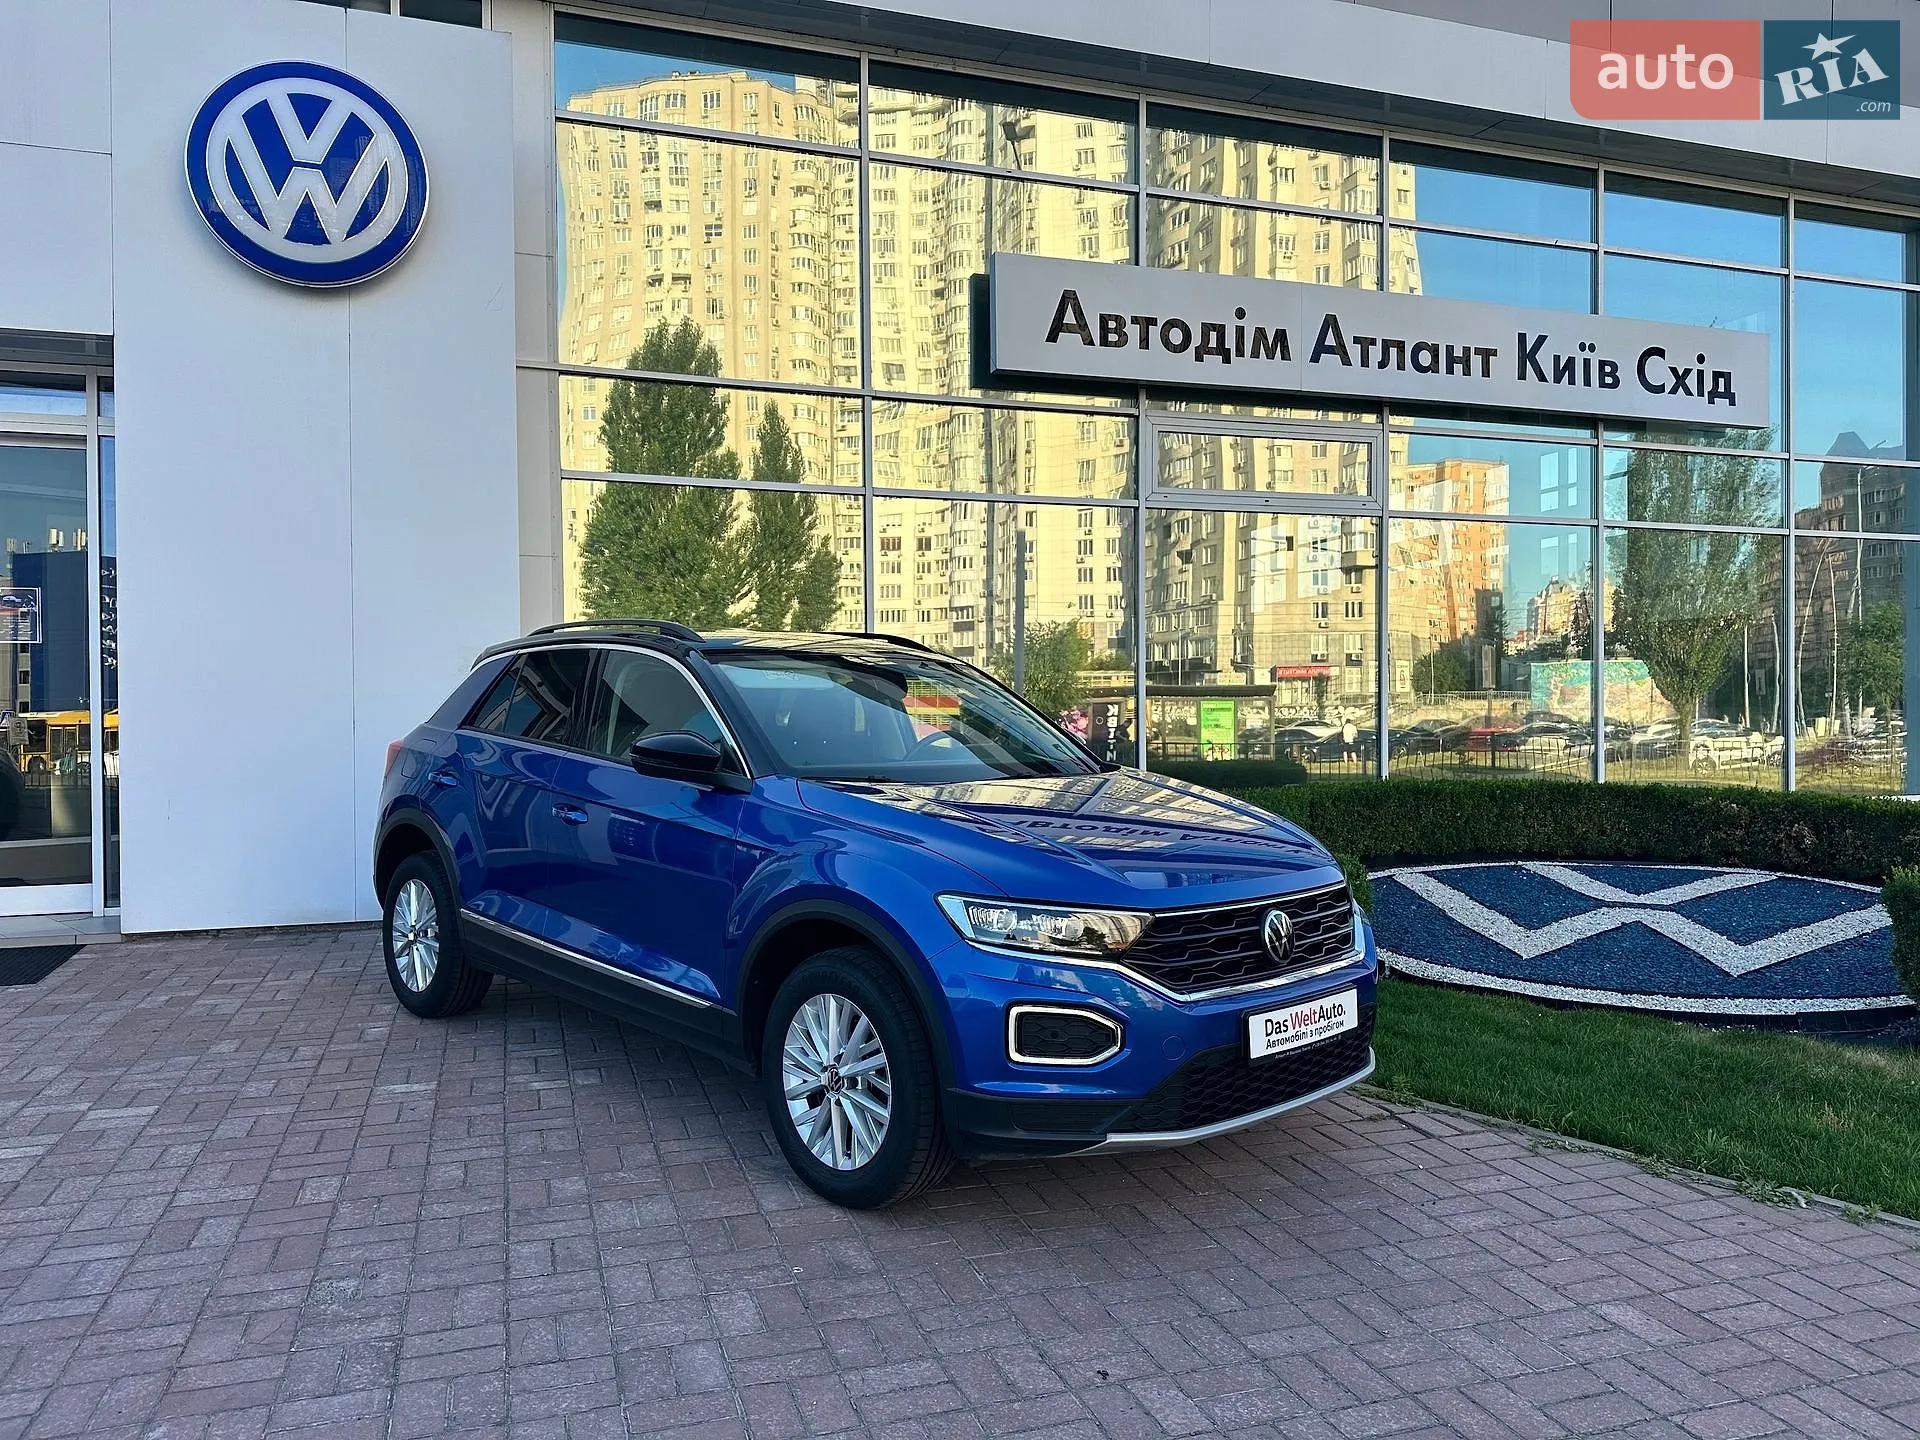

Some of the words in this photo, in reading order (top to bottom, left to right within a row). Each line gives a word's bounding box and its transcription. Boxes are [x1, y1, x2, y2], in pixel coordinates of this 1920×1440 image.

[1045, 289, 1292, 365] Автодім
[1309, 313, 1498, 378] Атлант
[1517, 331, 1621, 390] Київ
[1636, 346, 1737, 406] Схід
[1265, 1018, 1288, 1037] Das
[1266, 1030, 1308, 1049] Автомобілі
[1315, 1020, 1344, 1036] пробігом
